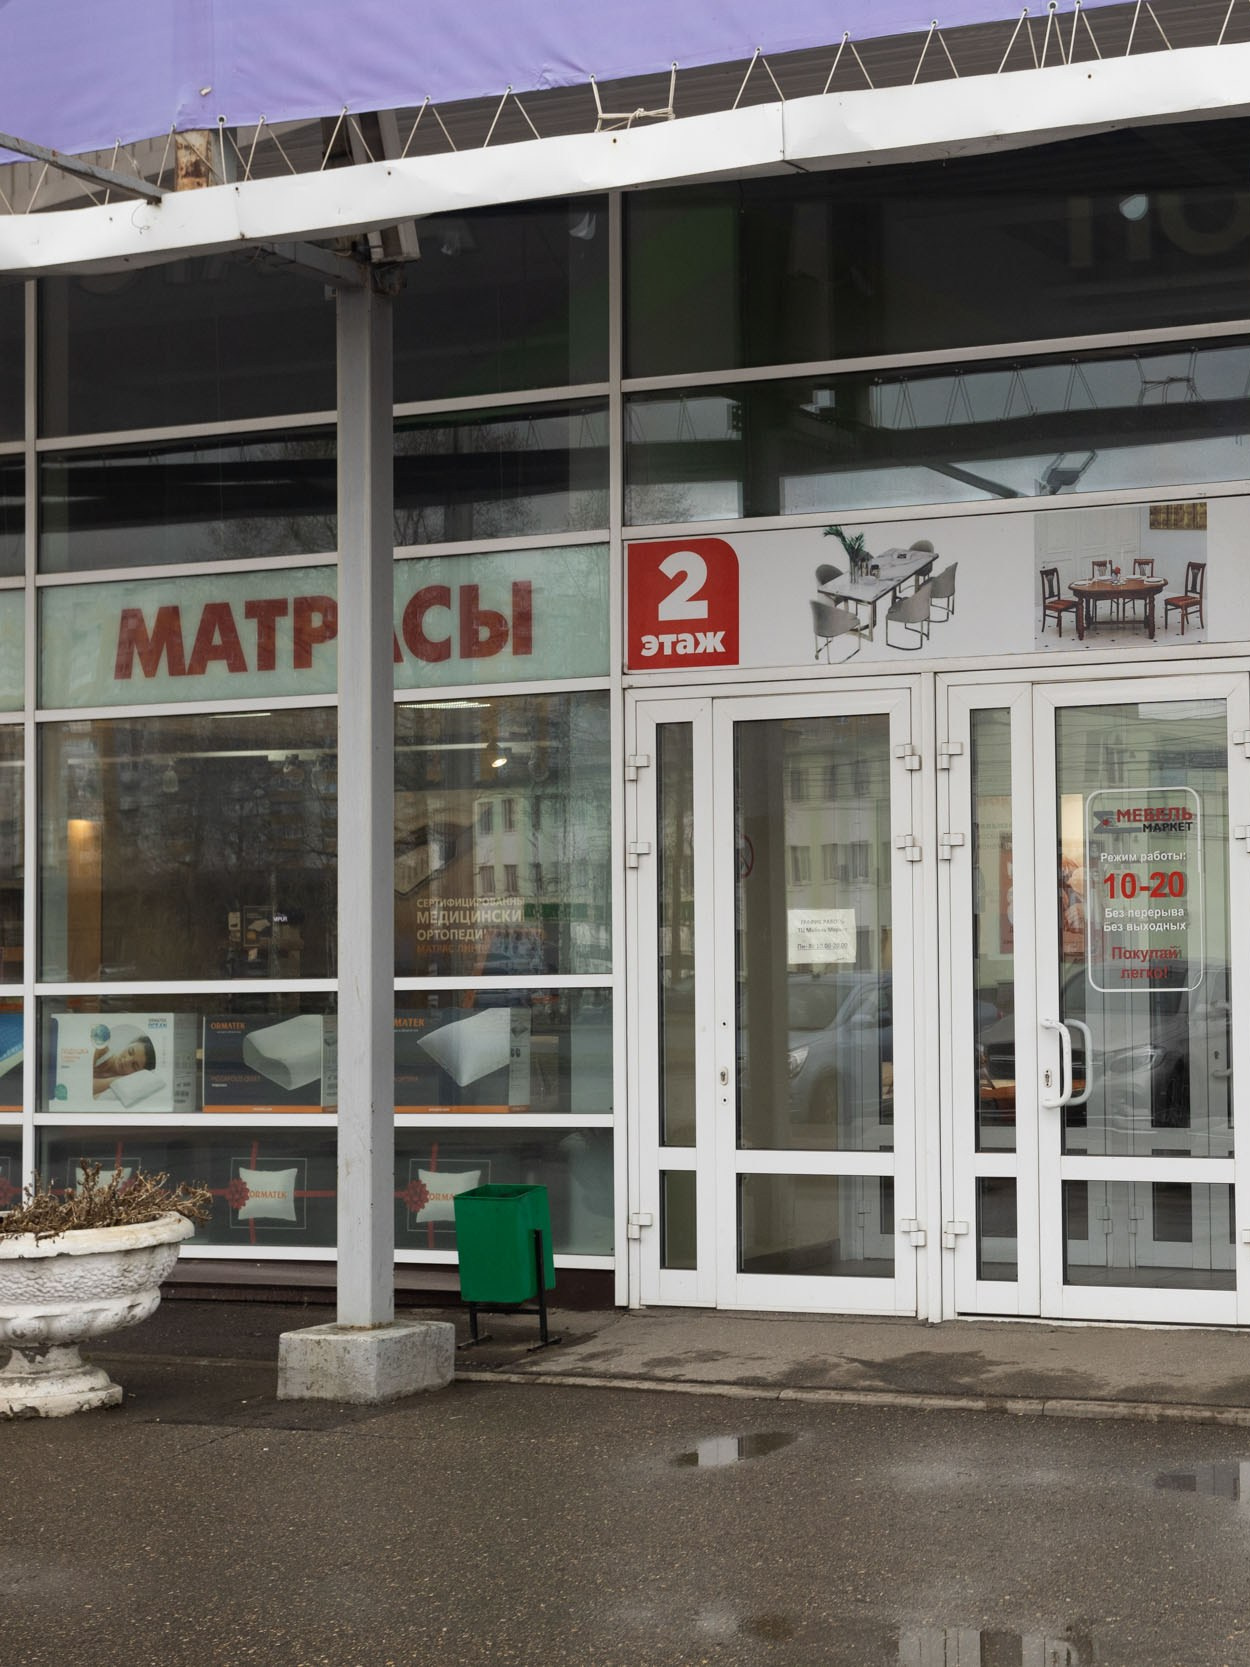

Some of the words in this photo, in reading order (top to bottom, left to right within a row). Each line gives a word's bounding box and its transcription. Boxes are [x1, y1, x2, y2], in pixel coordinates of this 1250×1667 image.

[657, 551, 708, 621] 2
[113, 580, 533, 680] МАТРСЫ
[640, 628, 725, 657] этаж
[1117, 807, 1193, 822] МЕБЕЛЬ
[1143, 822, 1193, 832] МАРКЕТ
[1101, 852, 1137, 862] Режим
[1140, 851, 1187, 864] работы:
[1103, 871, 1185, 899] 10-20
[416, 910, 525, 926] МЕДИЦИНСКИ
[1105, 908, 1125, 918] Без
[1128, 908, 1184, 919] перерыва
[1103, 922, 1124, 932] Без
[1126, 921, 1186, 932] выходных
[416, 928, 486, 942] ОРТОПЕДИ
[1112, 945, 1180, 960] Покупай
[1121, 966, 1168, 979] легко!
[394, 1018, 424, 1028] MATEK
